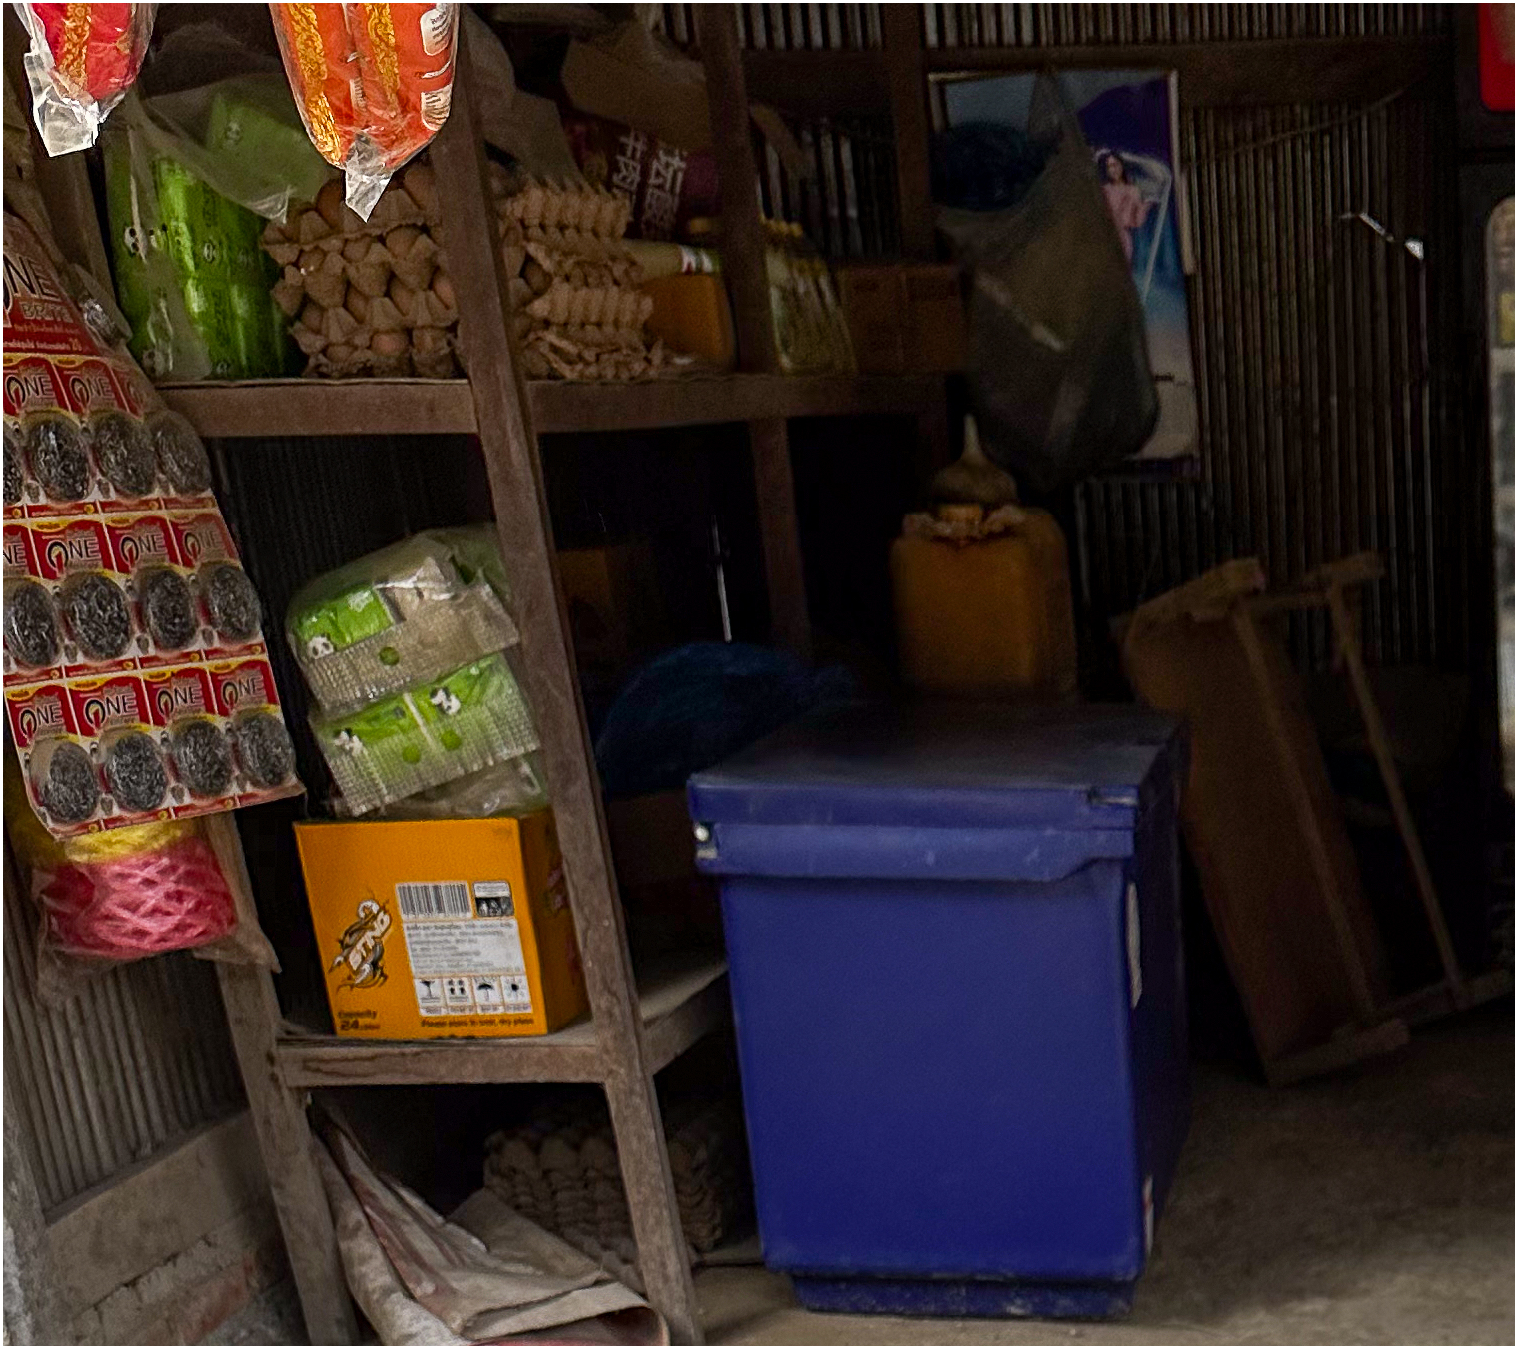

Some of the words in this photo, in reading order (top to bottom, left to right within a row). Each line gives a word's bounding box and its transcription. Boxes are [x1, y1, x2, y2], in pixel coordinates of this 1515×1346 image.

[6, 374, 56, 408] ONE
[47, 539, 101, 574] ONE
[119, 533, 167, 568] ONE
[157, 685, 203, 720] ONE
[221, 677, 265, 712] ONE
[19, 702, 63, 746] ONE
[84, 695, 138, 733] ONE
